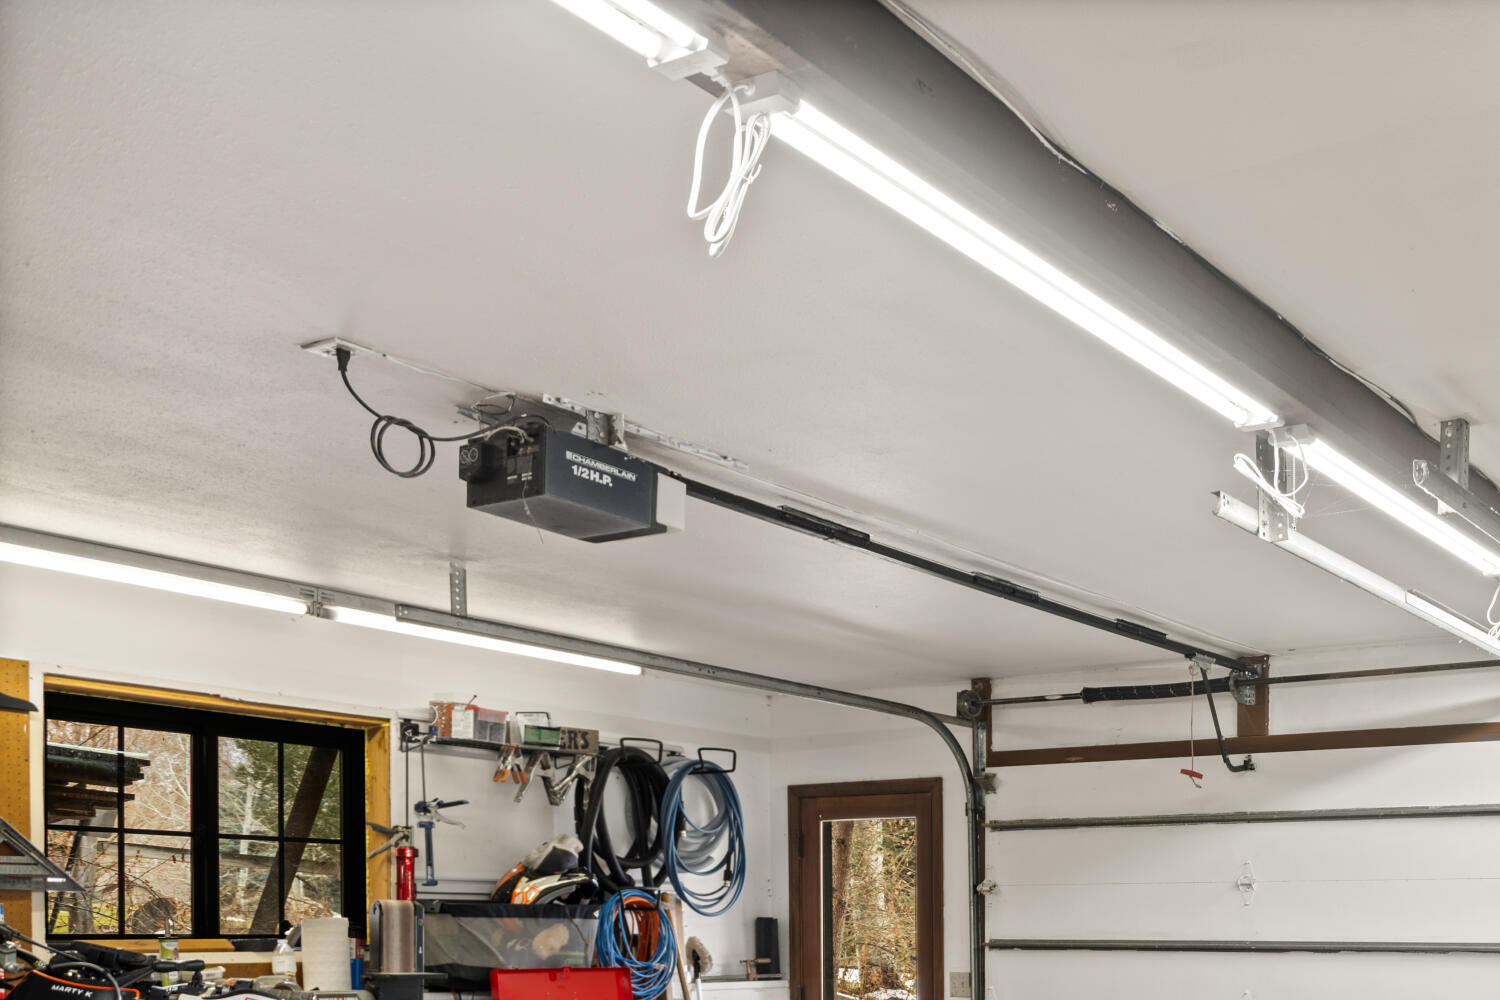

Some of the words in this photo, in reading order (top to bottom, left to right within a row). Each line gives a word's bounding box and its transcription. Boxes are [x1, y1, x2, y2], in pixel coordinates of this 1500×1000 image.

[572, 454, 637, 482] CHAMBERLAIN
[51, 984, 84, 996] MARTY
[84, 990, 93, 998] K
